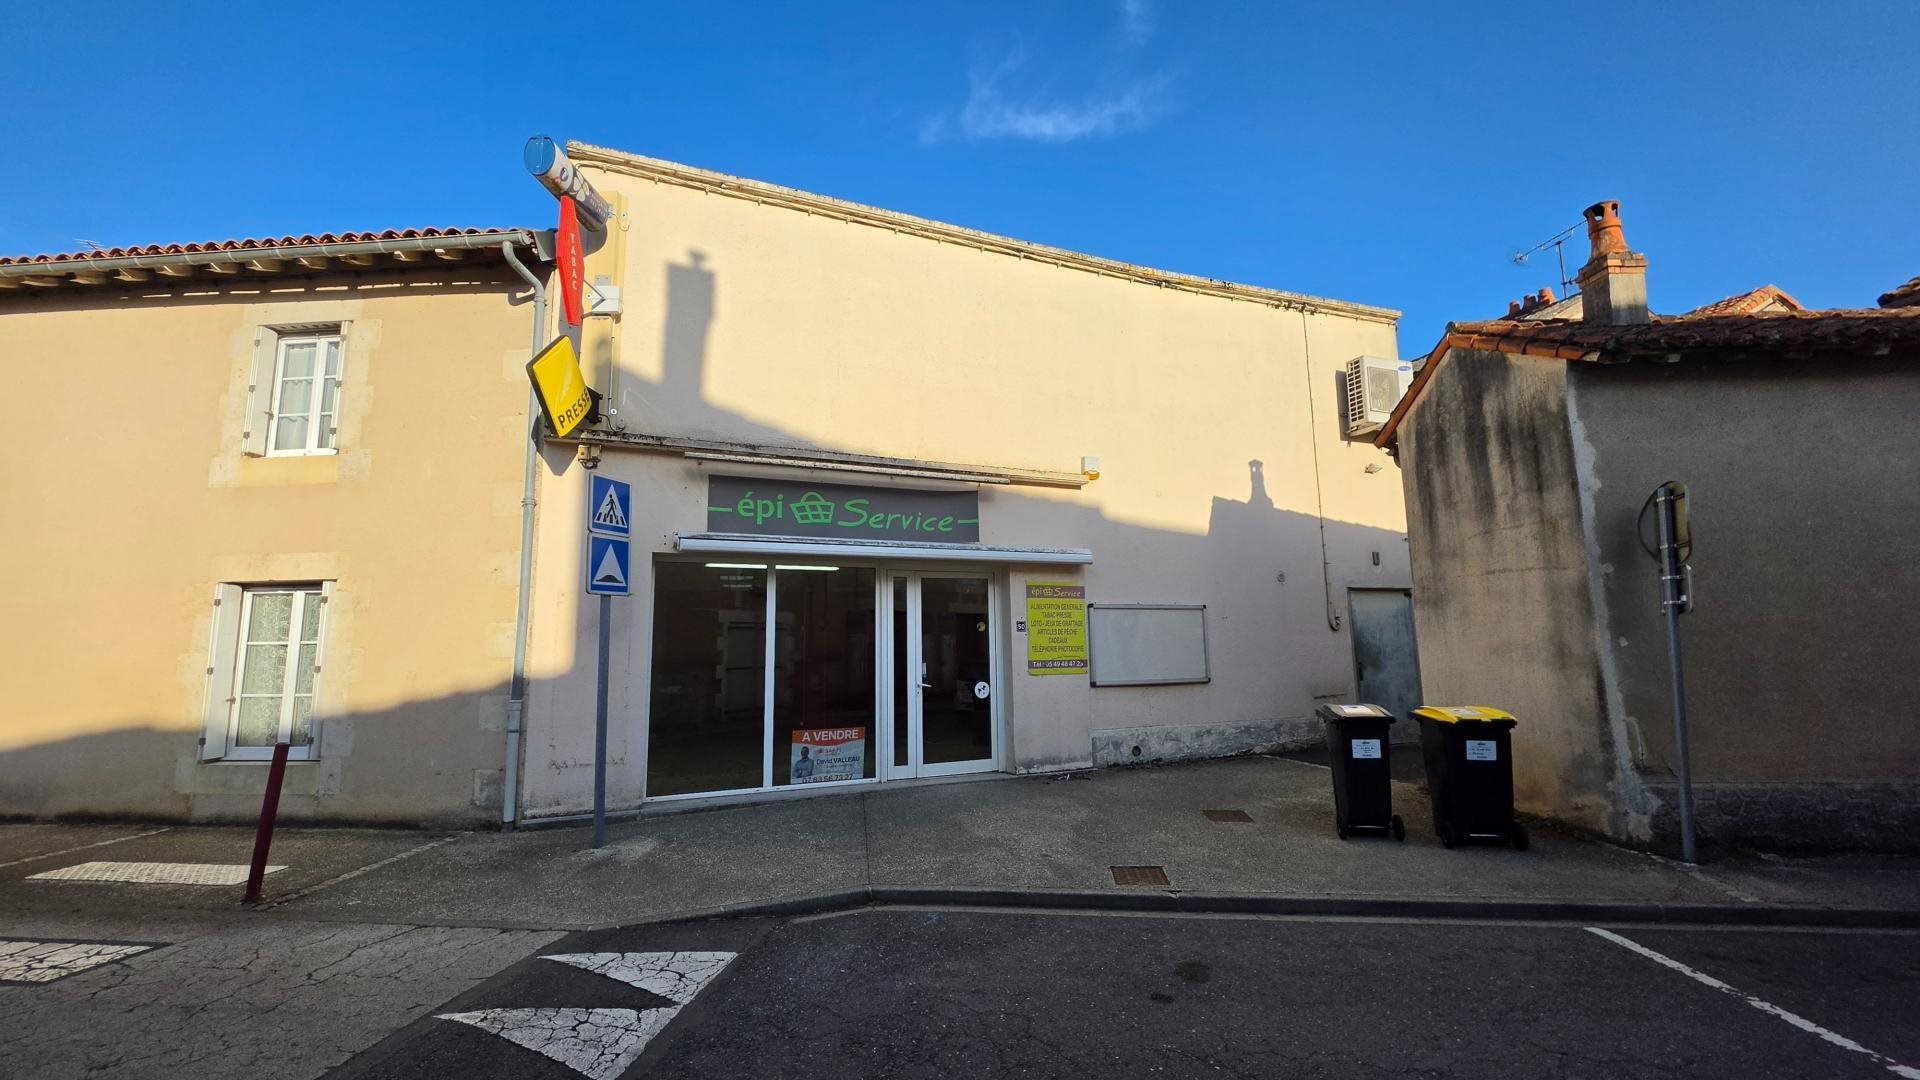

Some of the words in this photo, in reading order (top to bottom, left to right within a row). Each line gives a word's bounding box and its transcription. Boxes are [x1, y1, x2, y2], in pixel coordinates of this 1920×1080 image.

[570, 233, 578, 290] TABAC
[558, 388, 591, 429] PRESSE
[737, 492, 784, 525] épi
[837, 499, 953, 532] Service
[1054, 587, 1081, 597] Service
[801, 732, 811, 742] A
[813, 729, 859, 741] VENDRE
